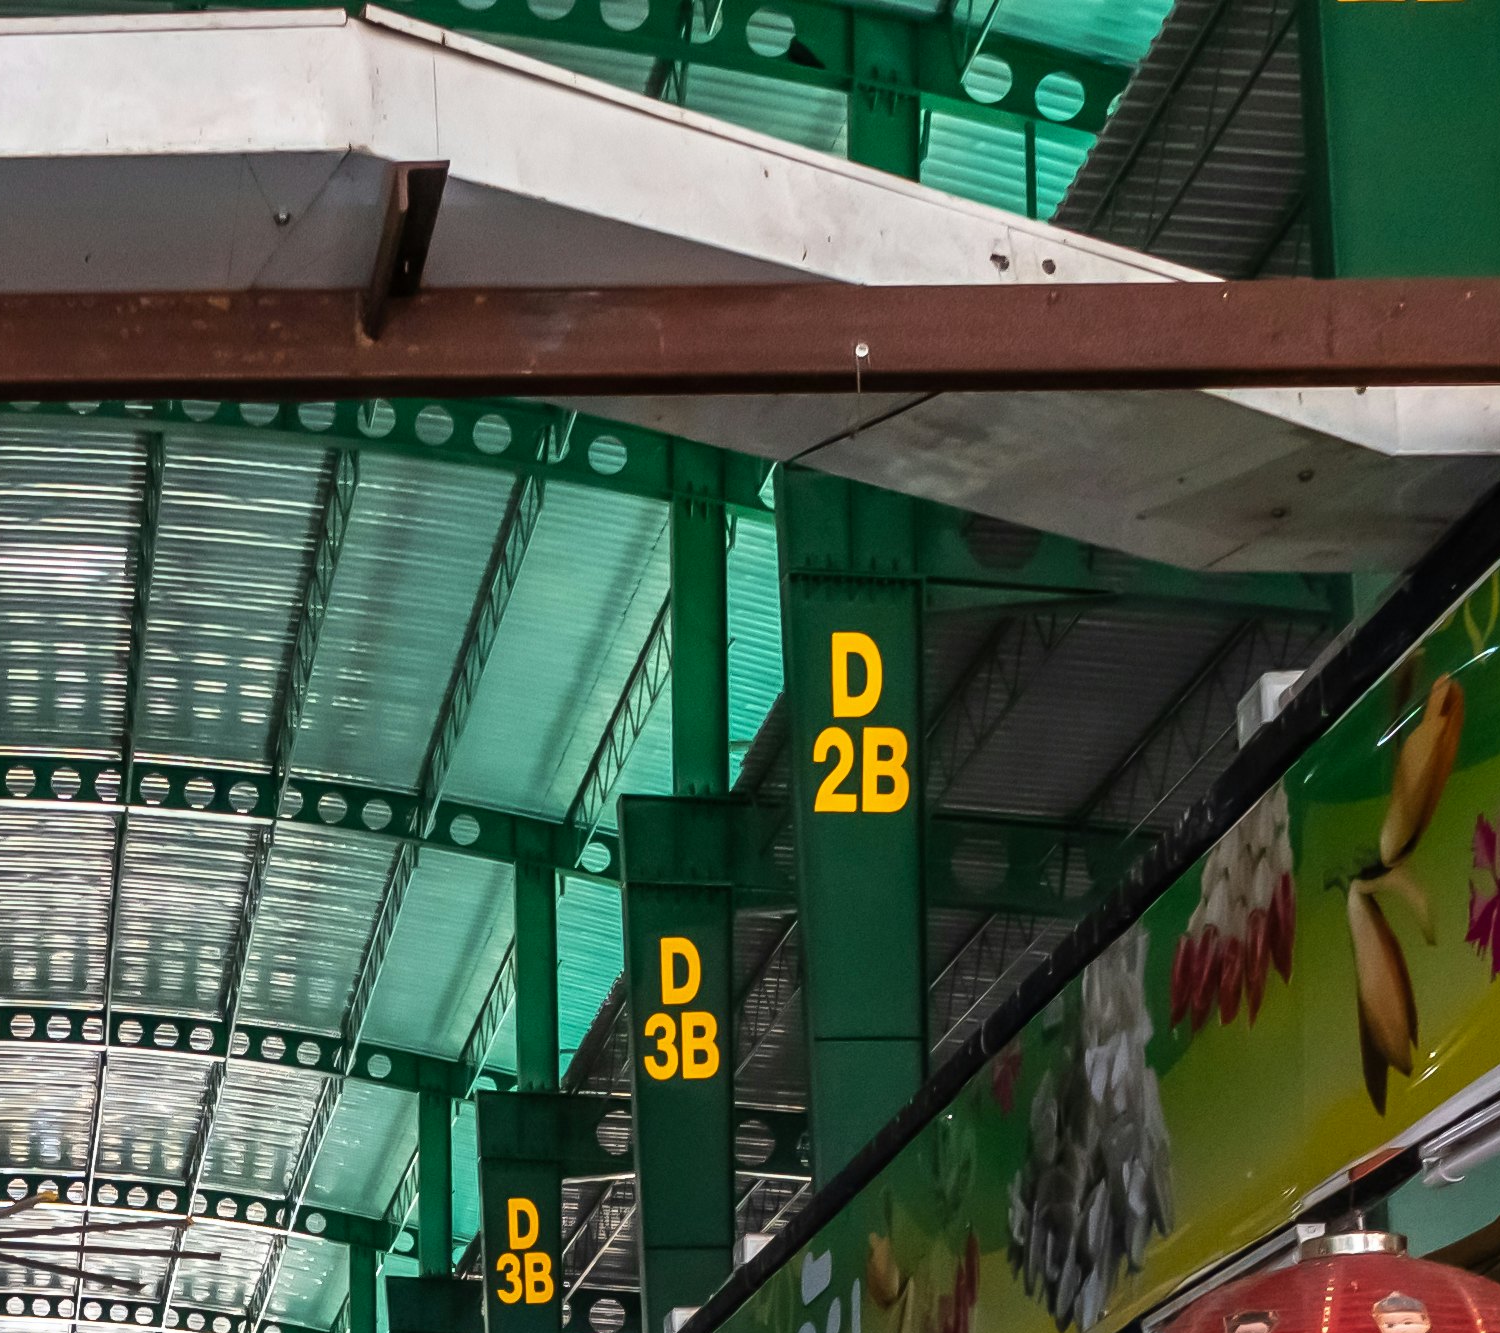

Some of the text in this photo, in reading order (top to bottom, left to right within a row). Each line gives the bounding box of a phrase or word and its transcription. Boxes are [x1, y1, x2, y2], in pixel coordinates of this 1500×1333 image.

[831, 631, 883, 718] D
[813, 727, 910, 813] 2B
[660, 937, 702, 1005] D
[643, 1011, 721, 1081] 3B
[508, 1198, 539, 1250] D
[496, 1253, 554, 1304] 3B
